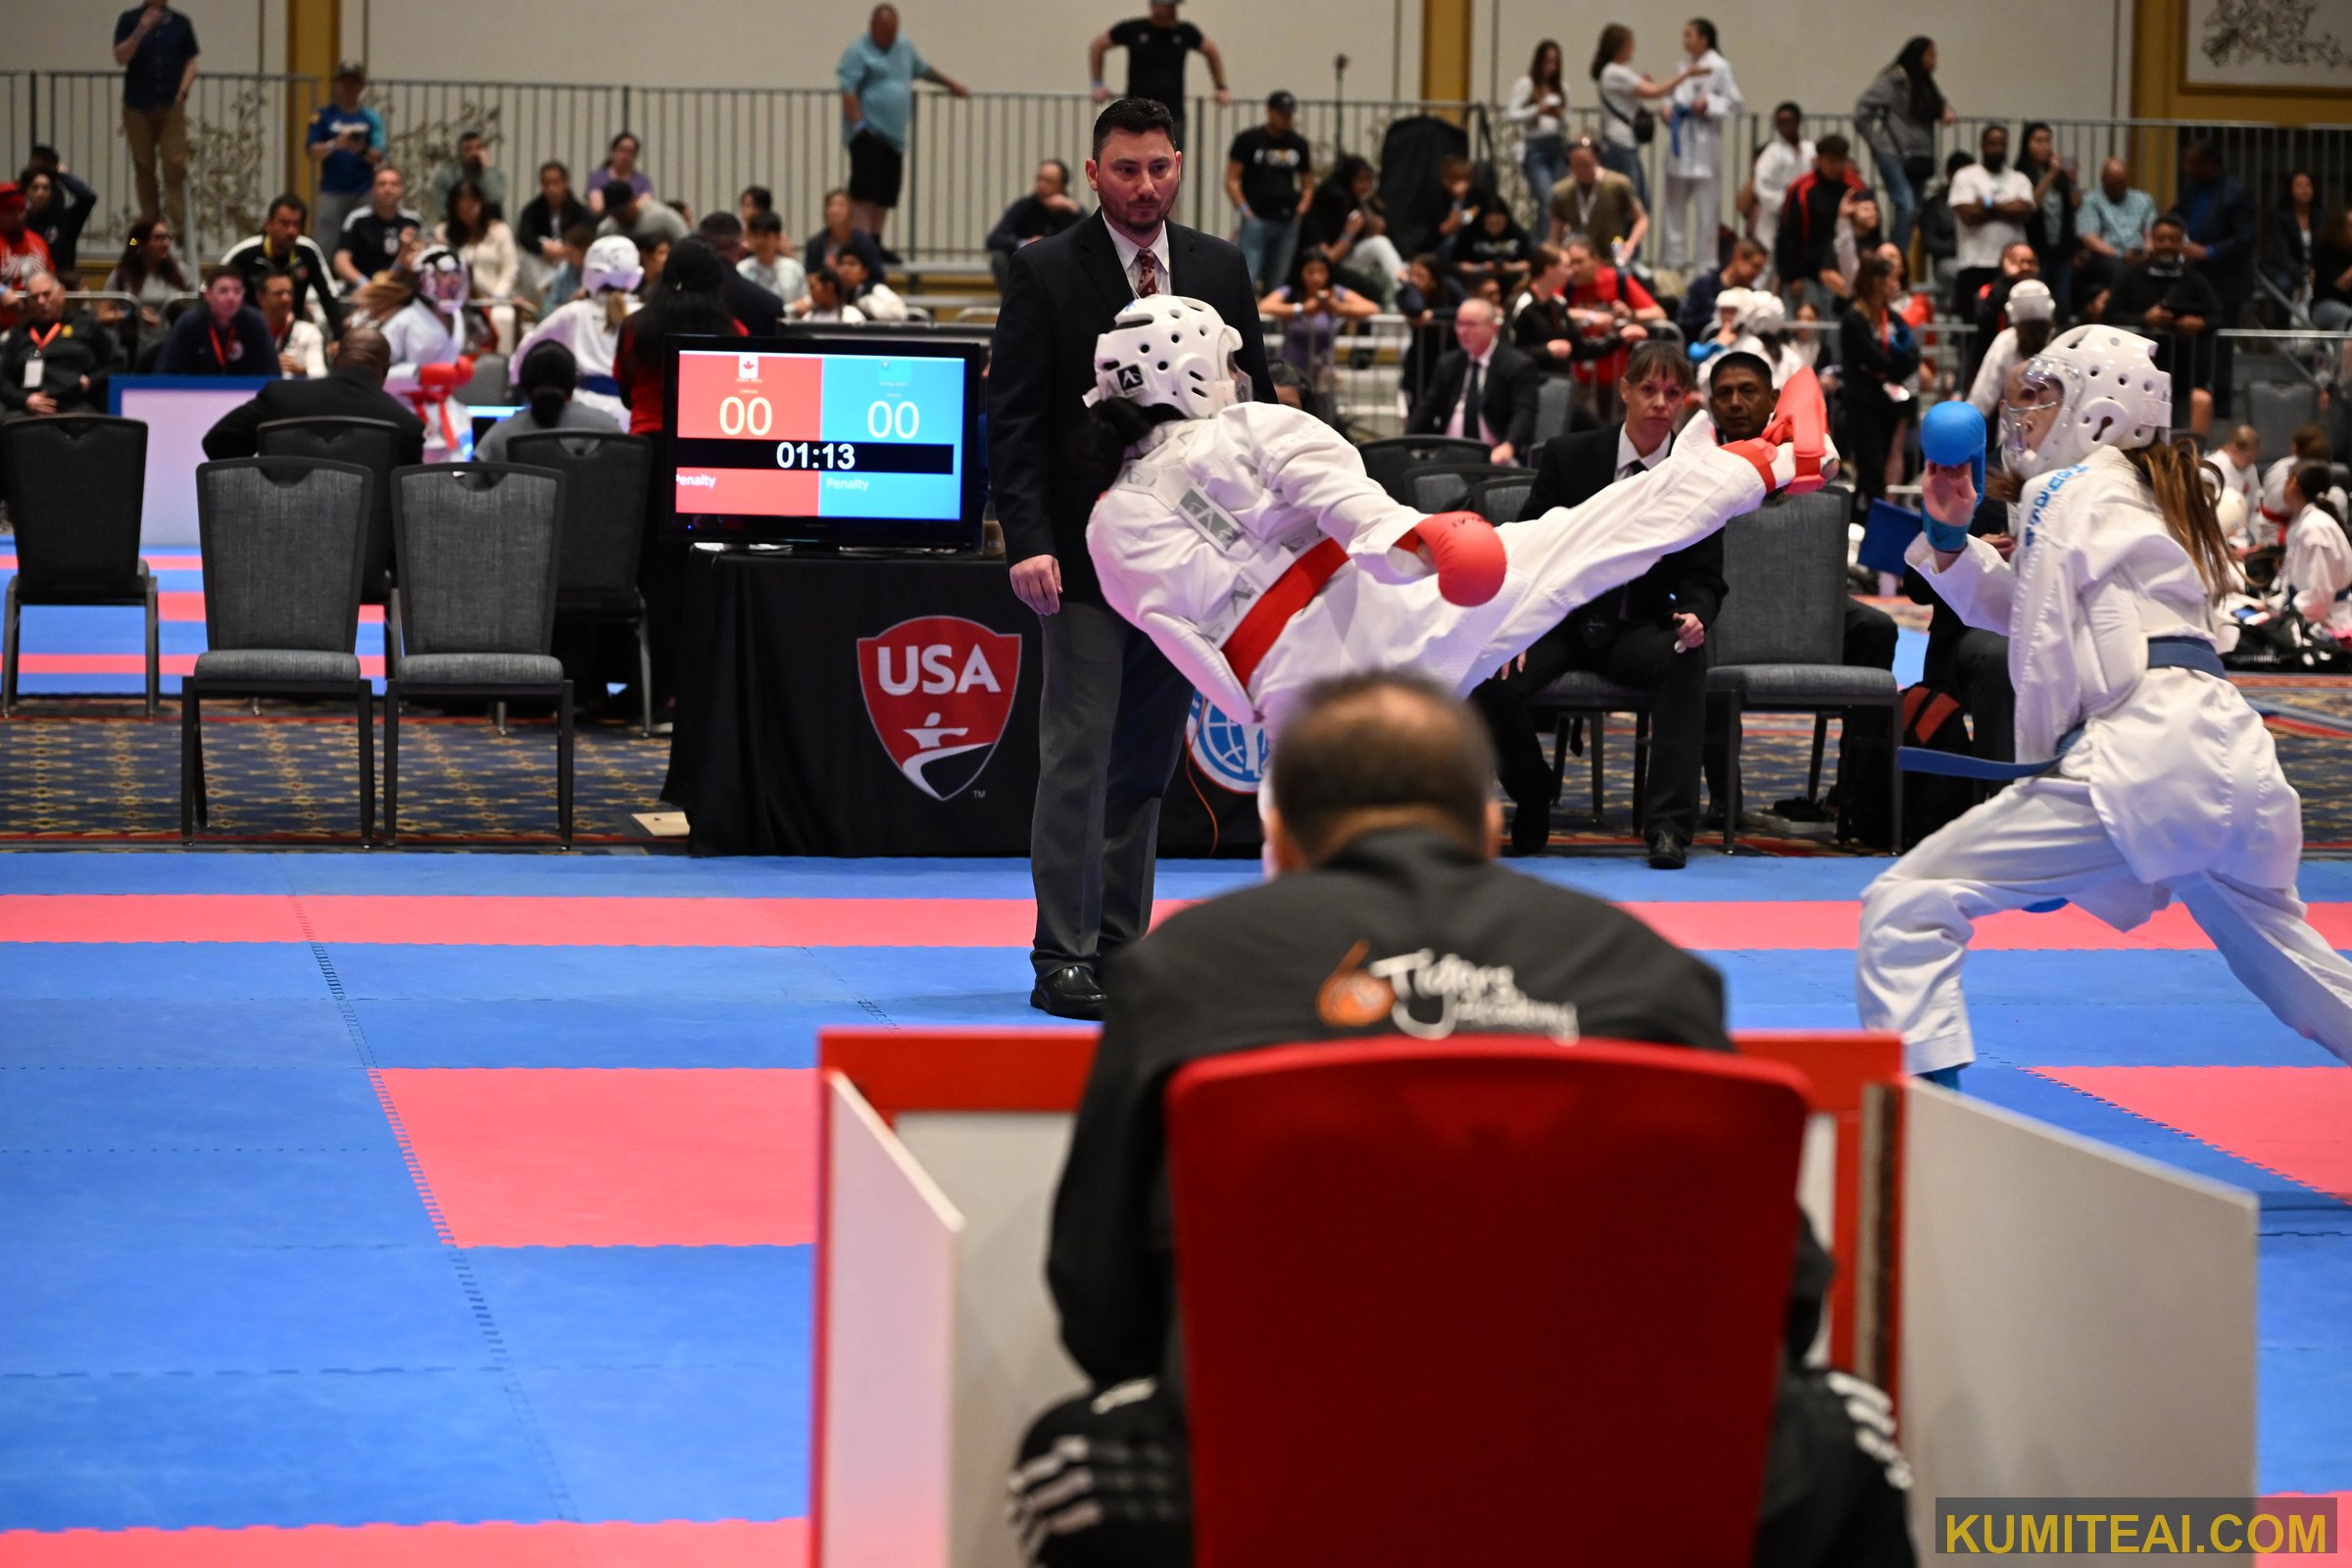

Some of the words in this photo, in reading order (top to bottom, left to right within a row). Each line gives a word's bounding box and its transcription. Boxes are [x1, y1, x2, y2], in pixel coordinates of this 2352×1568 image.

[718, 396, 772, 436] 00
[867, 400, 919, 439] 00
[776, 441, 856, 470] 01:13
[826, 477, 869, 492] Penalty
[877, 643, 1002, 696] USA
